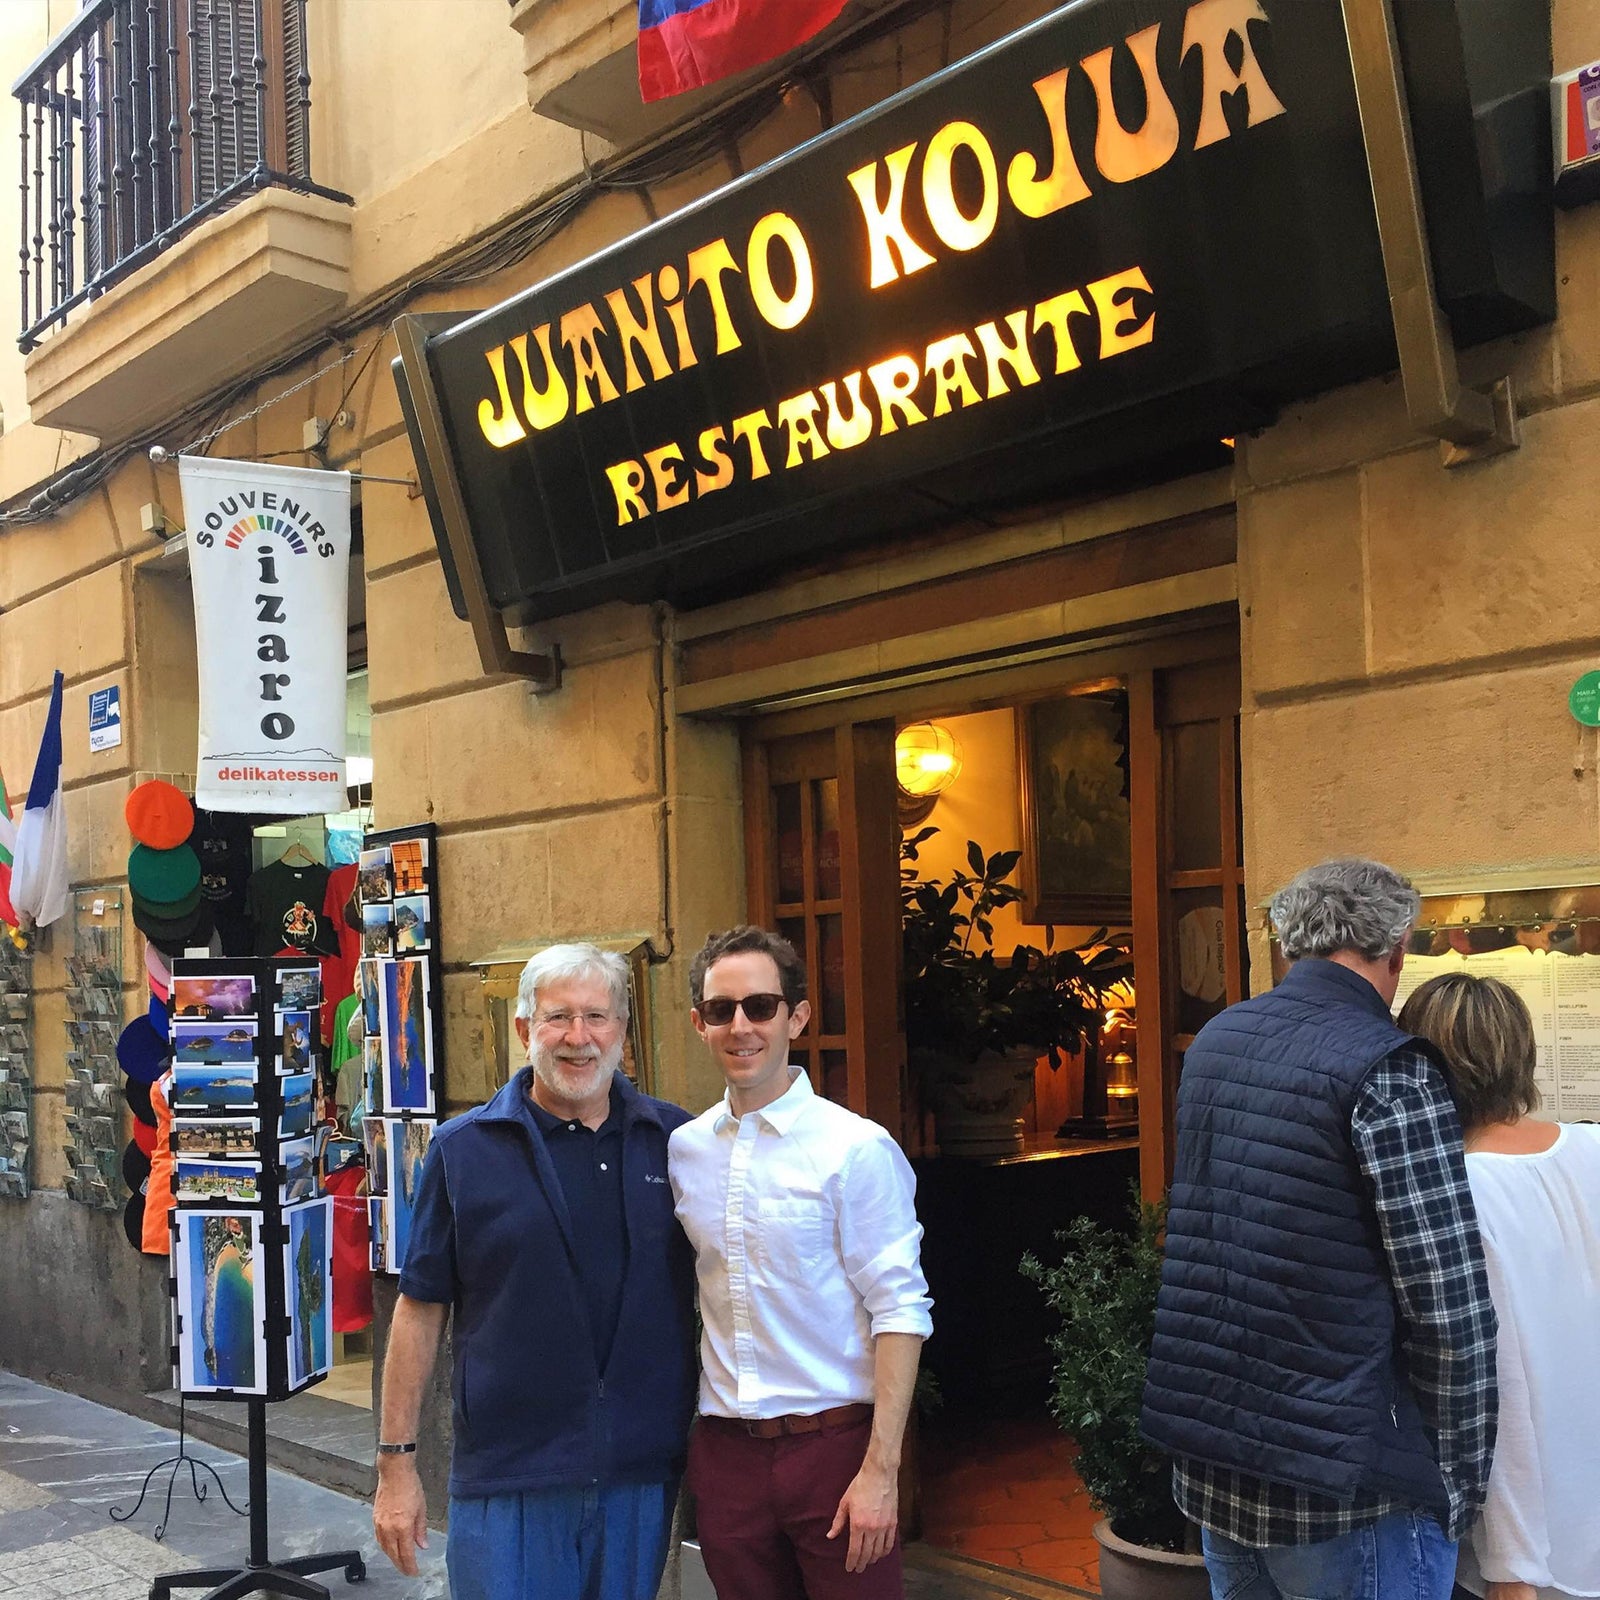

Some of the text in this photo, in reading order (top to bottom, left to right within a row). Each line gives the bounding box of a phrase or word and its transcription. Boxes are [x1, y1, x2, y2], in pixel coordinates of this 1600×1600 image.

[846, 0, 1287, 291] KOJUA
[605, 266, 1156, 526] RESTAURANTE
[196, 491, 335, 558] SOUVENIRS
[255, 546, 295, 740] izaro
[218, 767, 339, 782] delikatessen
